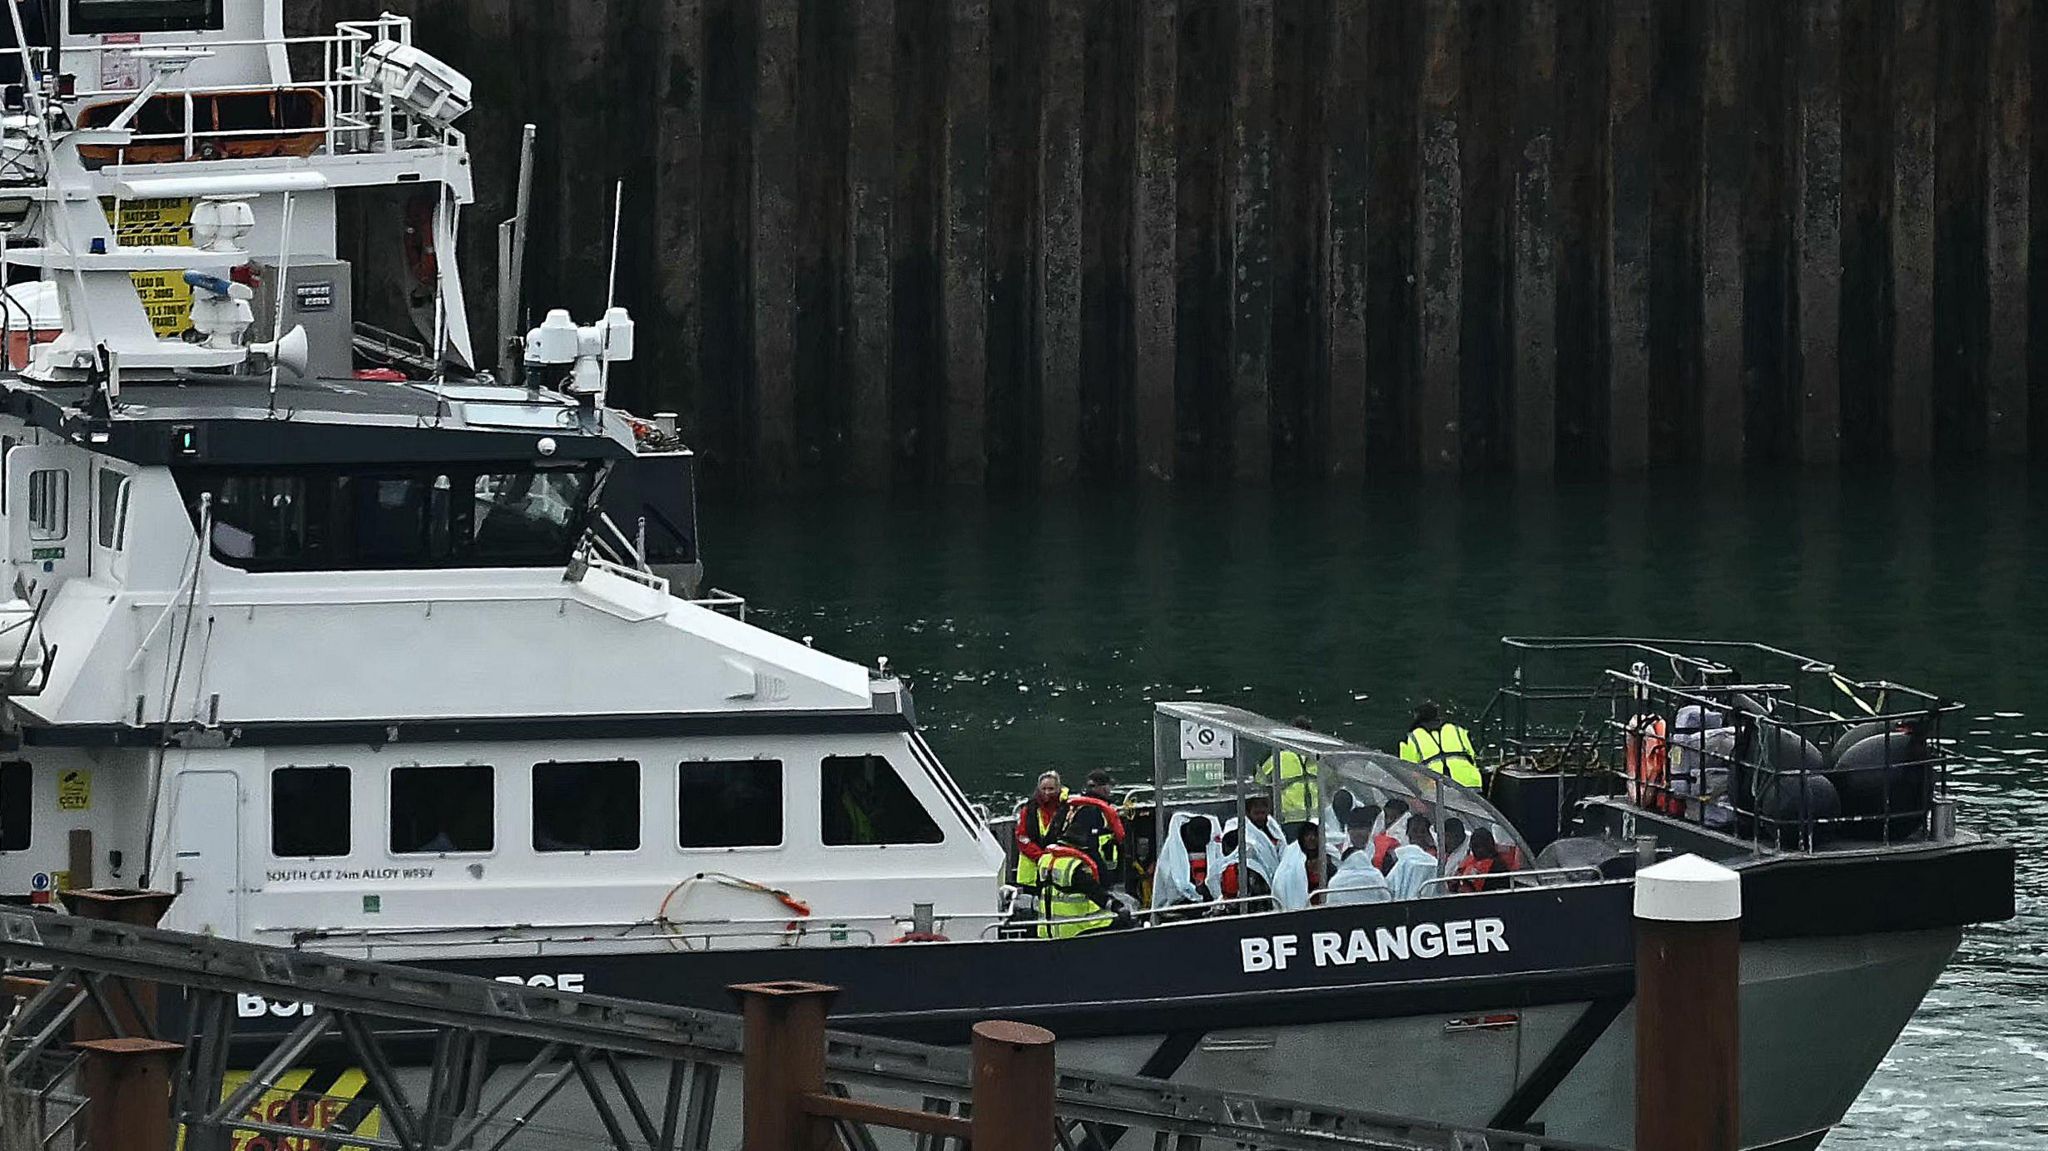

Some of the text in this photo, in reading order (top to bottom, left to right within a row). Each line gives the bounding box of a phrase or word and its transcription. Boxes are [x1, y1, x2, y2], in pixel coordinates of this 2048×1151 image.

[124, 211, 160, 222] HATCHES
[59, 795, 88, 805] CCTV
[266, 869, 307, 881] SOUTH
[310, 869, 332, 881] CAT
[361, 868, 398, 879] ALLOY
[1240, 917, 1510, 973] BF RANGER
